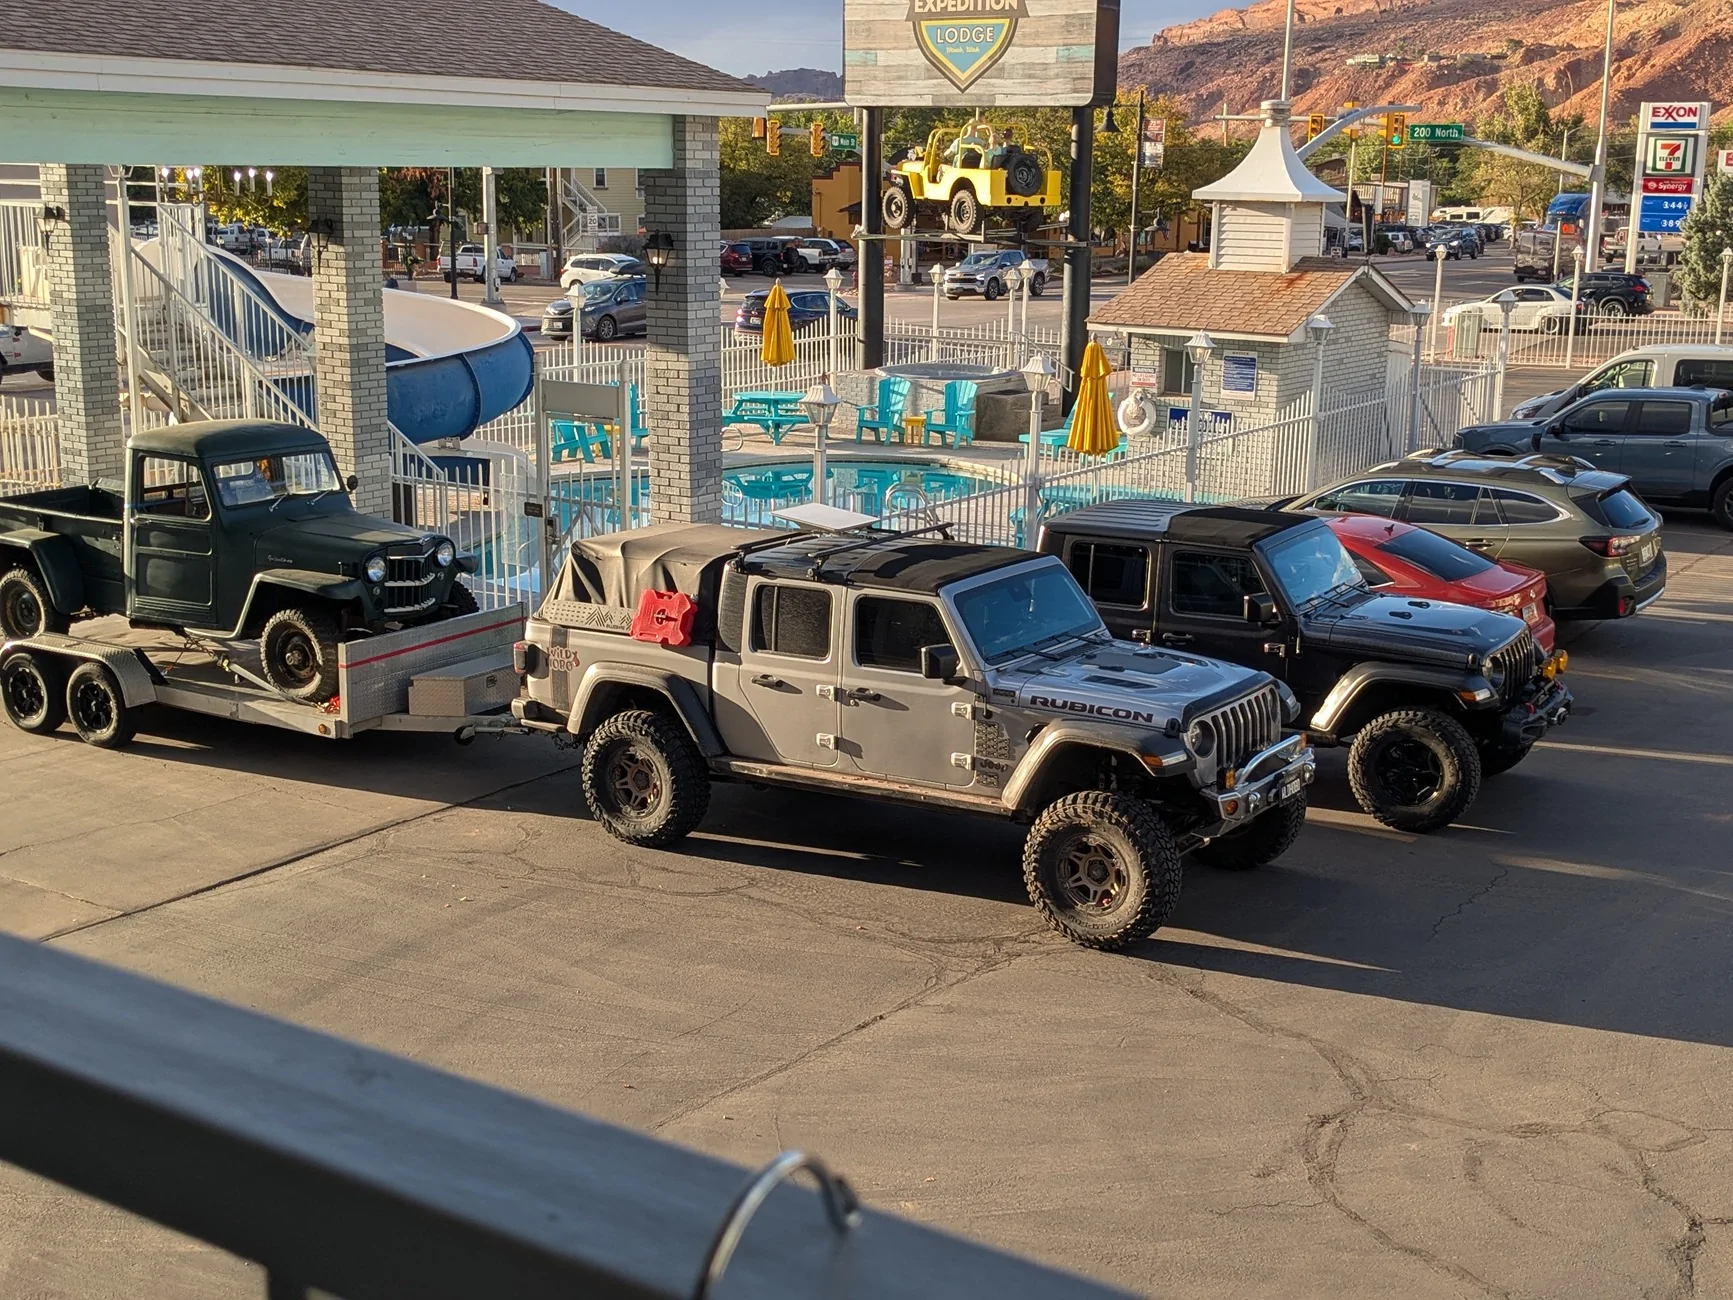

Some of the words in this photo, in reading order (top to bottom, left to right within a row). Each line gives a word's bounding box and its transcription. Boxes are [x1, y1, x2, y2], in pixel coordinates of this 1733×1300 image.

[914, 0, 1018, 13] EXPEDITION
[937, 27, 994, 44] LODGE
[1651, 105, 1698, 121] EXXON
[1414, 127, 1431, 137] 200
[1435, 127, 1458, 137] North
[1658, 182, 1687, 191] Synergy
[1030, 695, 1154, 723] RUBICON
[980, 759, 1008, 773] Jeep
